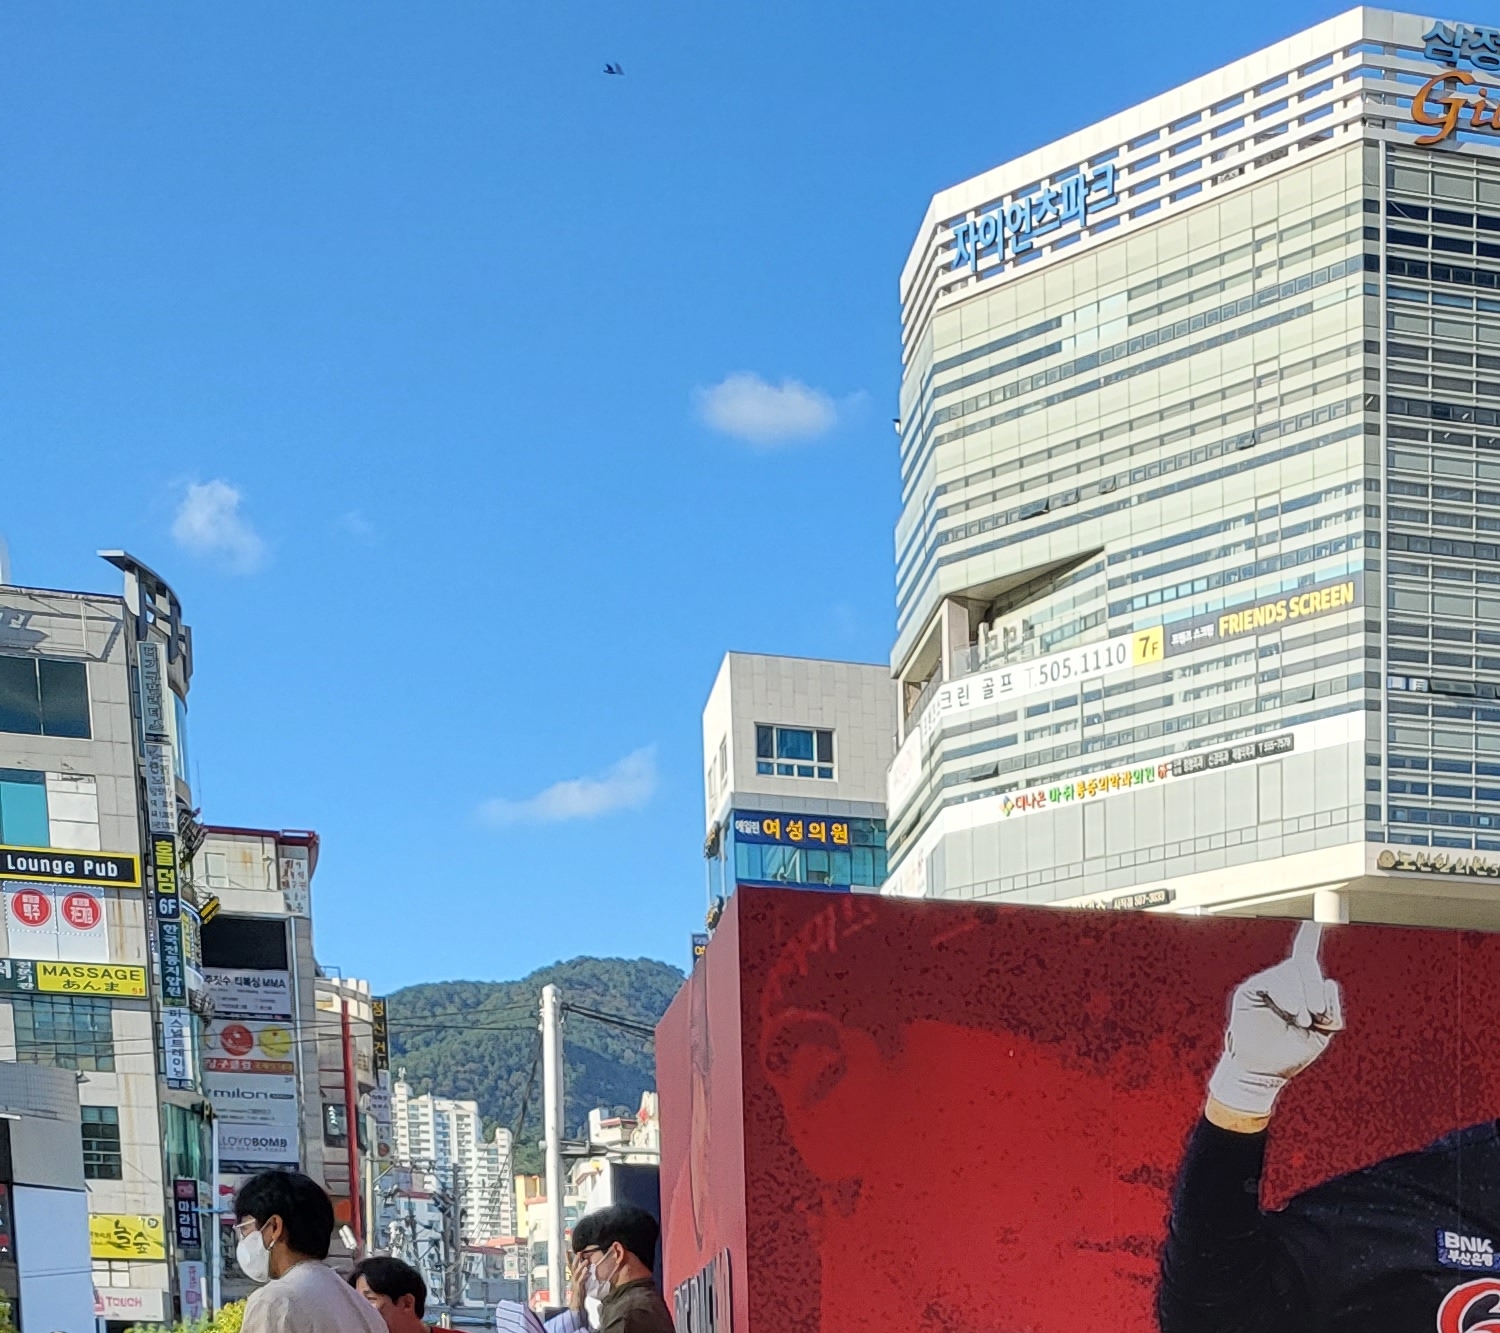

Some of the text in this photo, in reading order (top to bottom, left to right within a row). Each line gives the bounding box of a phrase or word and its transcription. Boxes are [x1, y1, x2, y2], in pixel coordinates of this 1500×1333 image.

[952, 163, 1117, 273] 자이언츠파크
[1218, 602, 1288, 639] FRIENDS
[1289, 581, 1355, 619] SCREEN
[981, 673, 1014, 700] 골프
[1138, 636, 1159, 659] 7F
[7, 854, 118, 877] Lounge Pub
[155, 840, 176, 894] 홀덤
[159, 898, 178, 915] 6F
[43, 964, 141, 981] MASSAGE
[204, 974, 231, 986] 주짓수
[262, 978, 286, 988] MMA
[63, 979, 120, 992] あんま
[213, 1088, 268, 1099] milon
[1444, 1231, 1494, 1253] BNK
[1448, 1249, 1493, 1267] 부산은행
[106, 1296, 143, 1308] TOUCH
